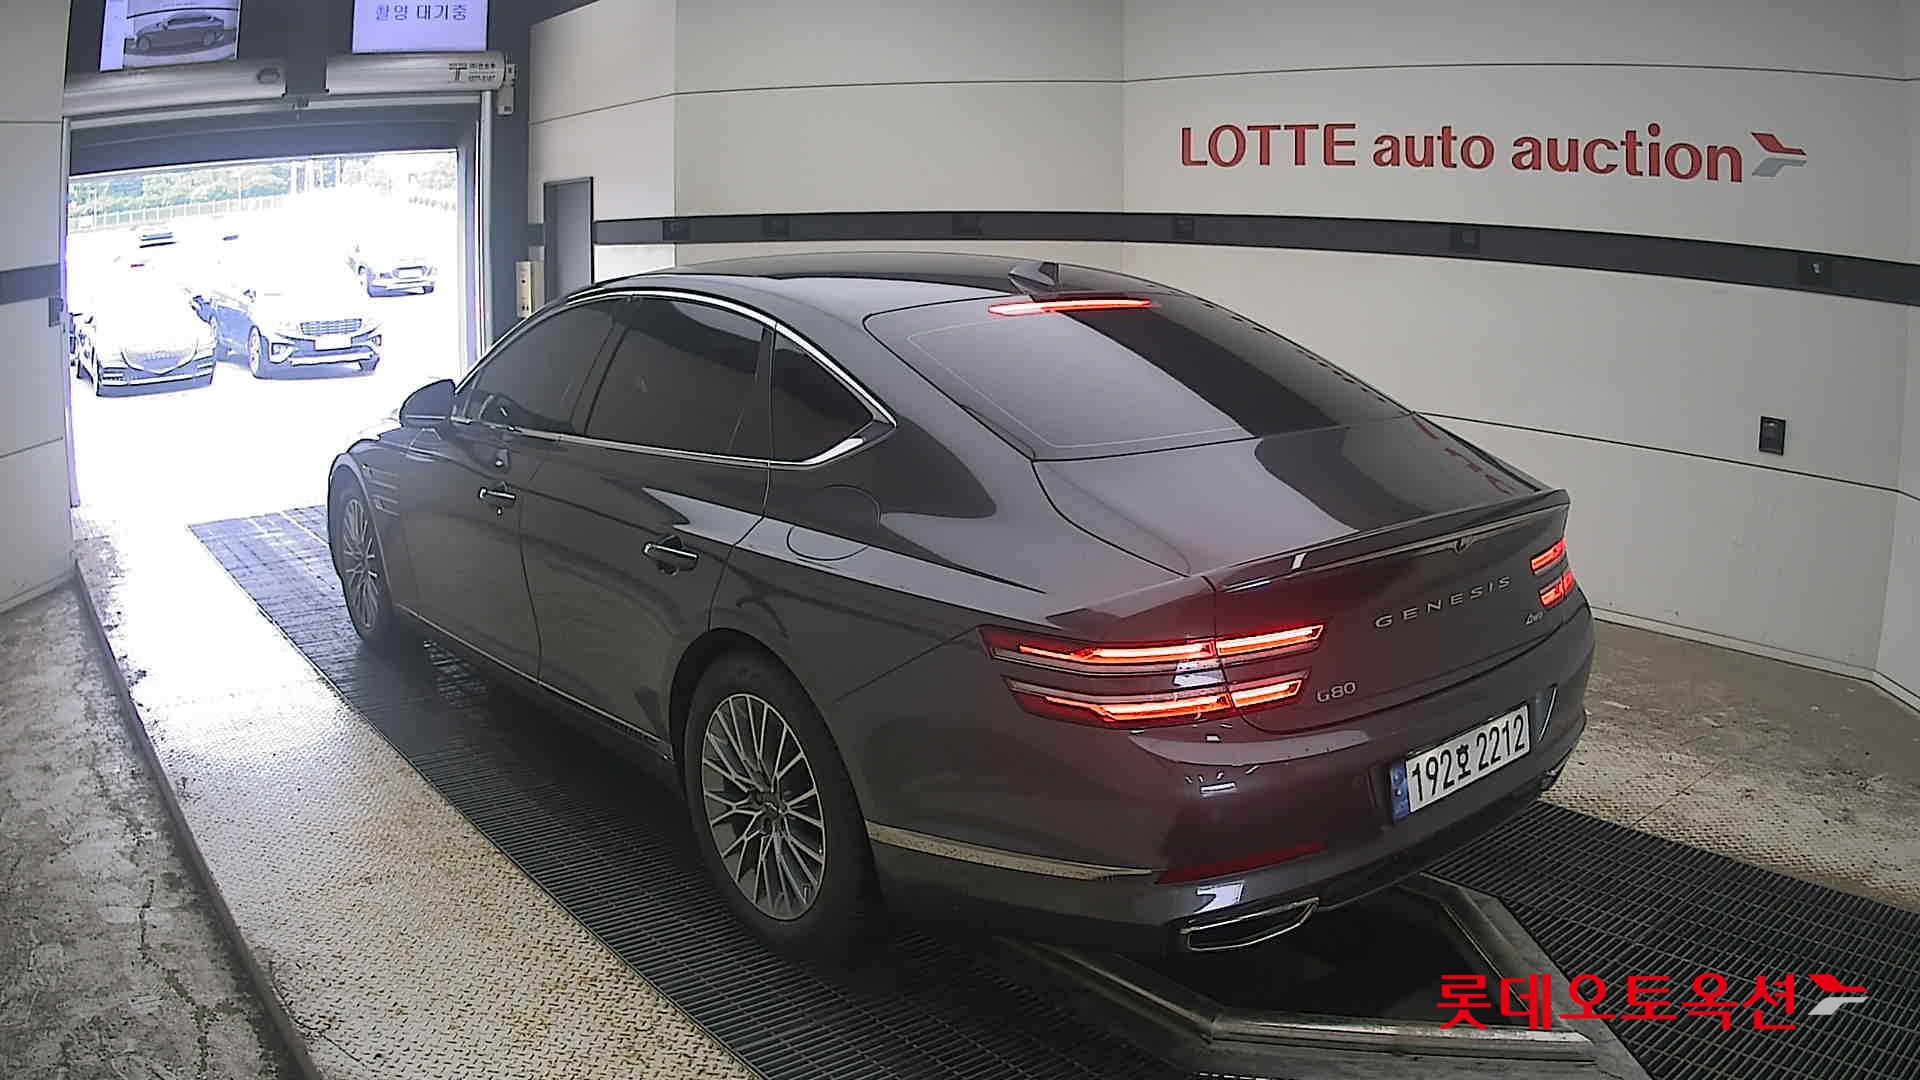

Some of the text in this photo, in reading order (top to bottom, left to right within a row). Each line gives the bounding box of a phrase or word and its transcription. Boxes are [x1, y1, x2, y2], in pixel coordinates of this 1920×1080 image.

[1181, 122, 1743, 183] LOTTE auto auction
[1375, 576, 1511, 628] GENESIS
[1317, 681, 1357, 703] G80
[1476, 715, 1525, 772] 2212
